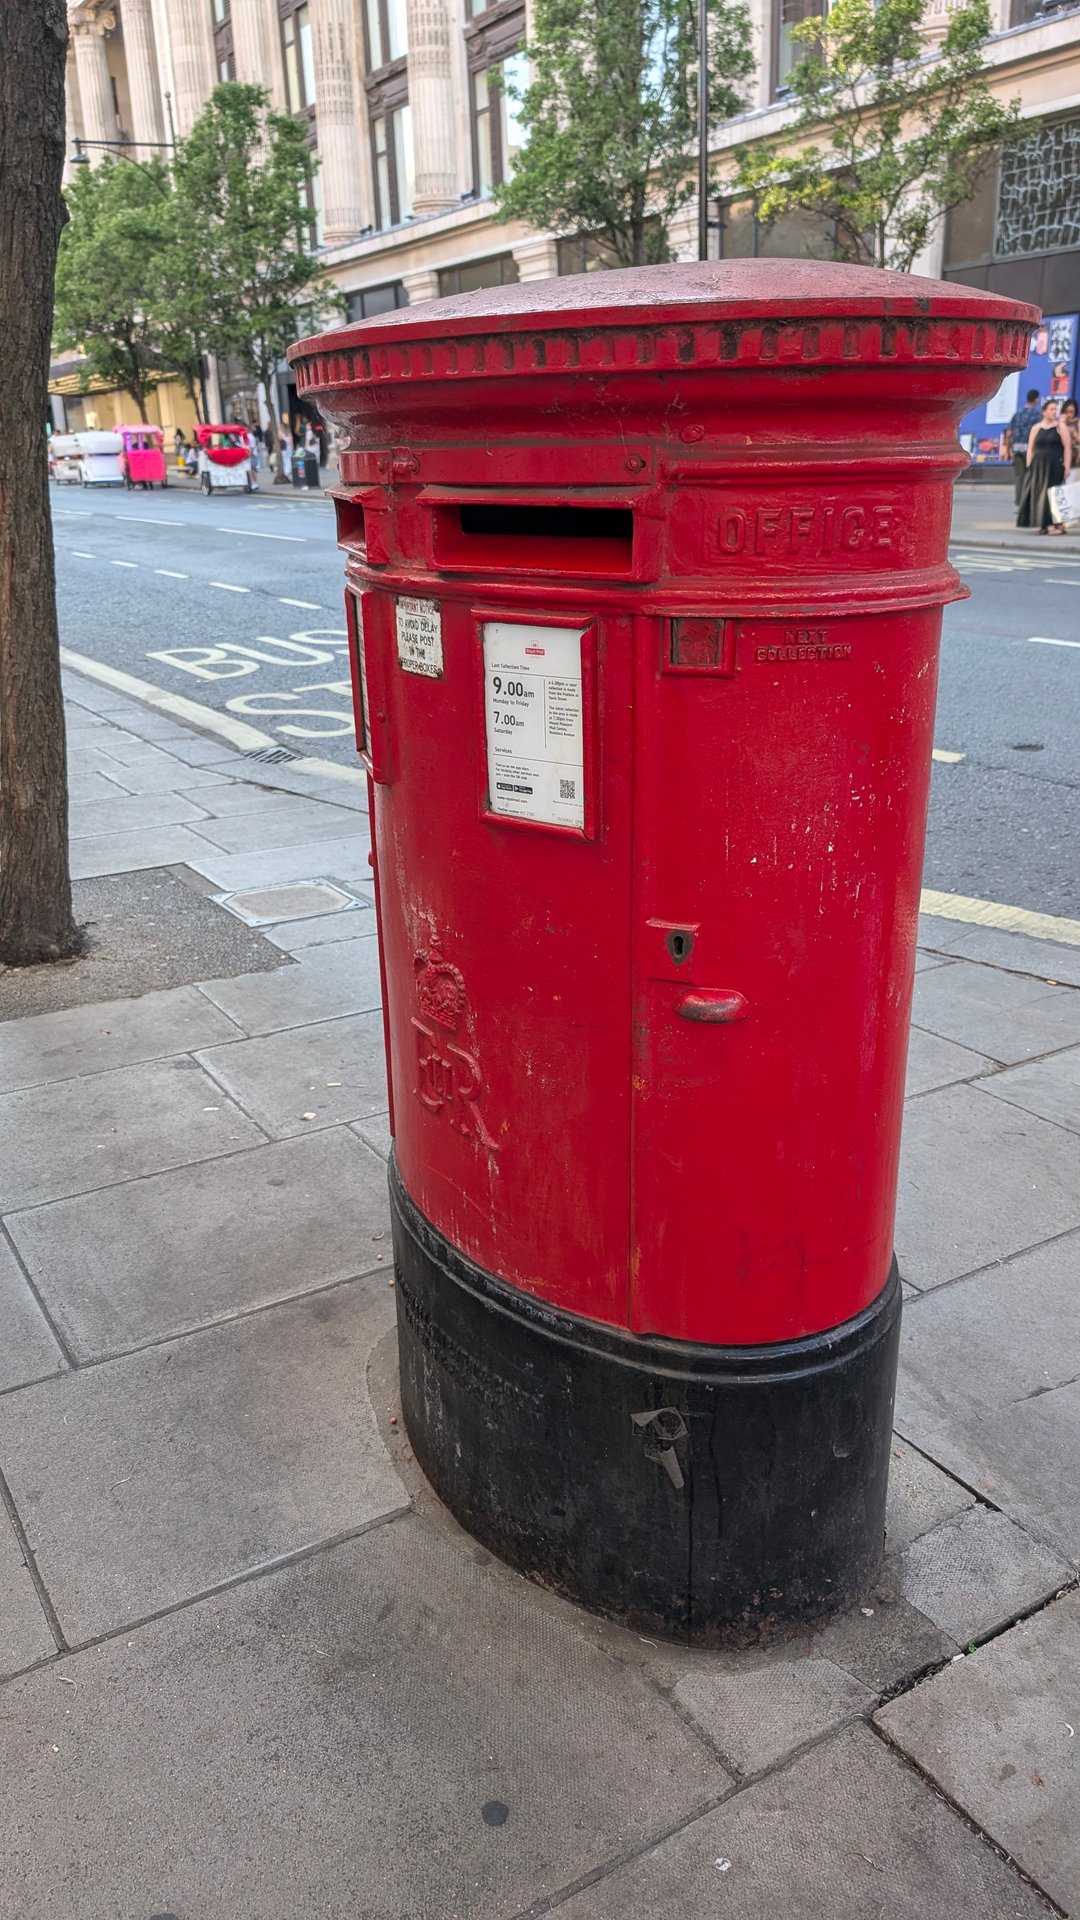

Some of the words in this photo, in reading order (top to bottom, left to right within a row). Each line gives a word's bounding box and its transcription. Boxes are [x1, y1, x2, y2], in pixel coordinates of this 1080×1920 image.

[716, 505, 893, 555] OFFICE
[405, 619, 419, 630] AVOID
[420, 620, 437, 633] DELAY
[401, 631, 418, 644] PLEASE
[420, 635, 434, 647] POST
[784, 628, 828, 645] NEXT
[146, 630, 348, 681] BUS
[755, 644, 852, 662] COLLECTION
[492, 676, 535, 698] 9.00am
[492, 698, 510, 706] Monday
[516, 700, 530, 708] Friday
[493, 711, 525, 727] 7.00am
[493, 727, 513, 735] Saturday
[494, 746, 513, 754] Services
